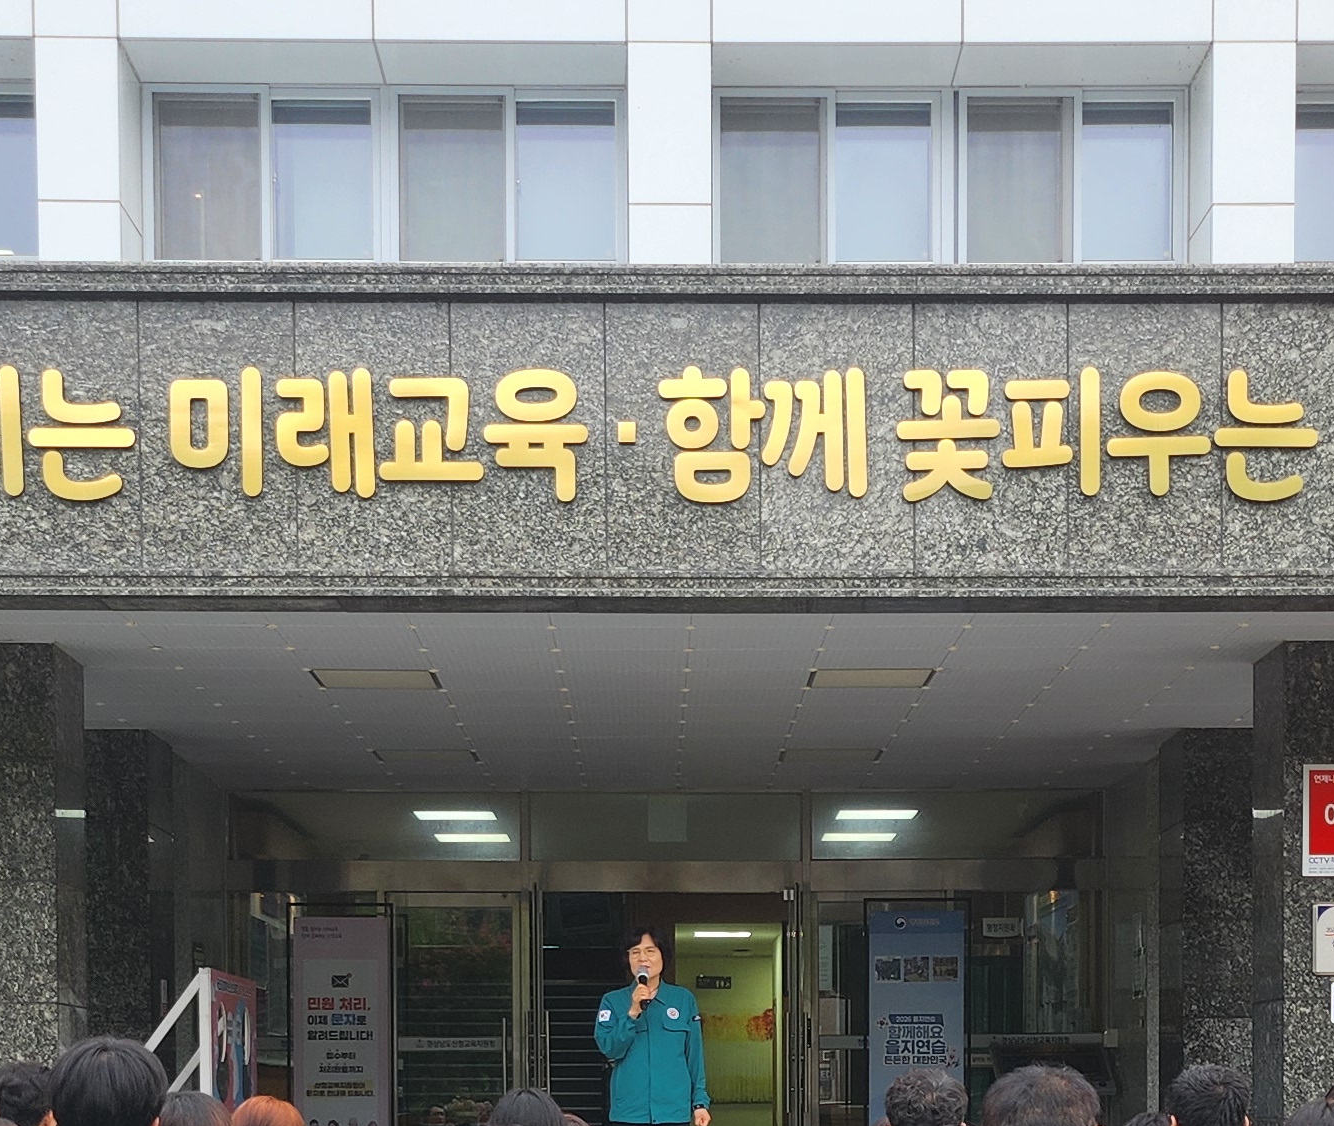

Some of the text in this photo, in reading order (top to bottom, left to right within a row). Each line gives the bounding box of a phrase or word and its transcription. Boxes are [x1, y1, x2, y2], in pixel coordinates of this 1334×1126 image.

[169, 366, 588, 501] 미래교육
[660, 367, 867, 504] 함께
[897, 368, 1318, 501] 꽃피우는
[307, 997, 334, 1011] 민원
[307, 1013, 367, 1026] 이제 문자로
[307, 1030, 373, 1041] 알려드립니다!
[888, 1025, 943, 1040] 함께해요
[885, 1040, 946, 1055] 을지연습
[884, 1056, 947, 1065] 든든한 대한민국
